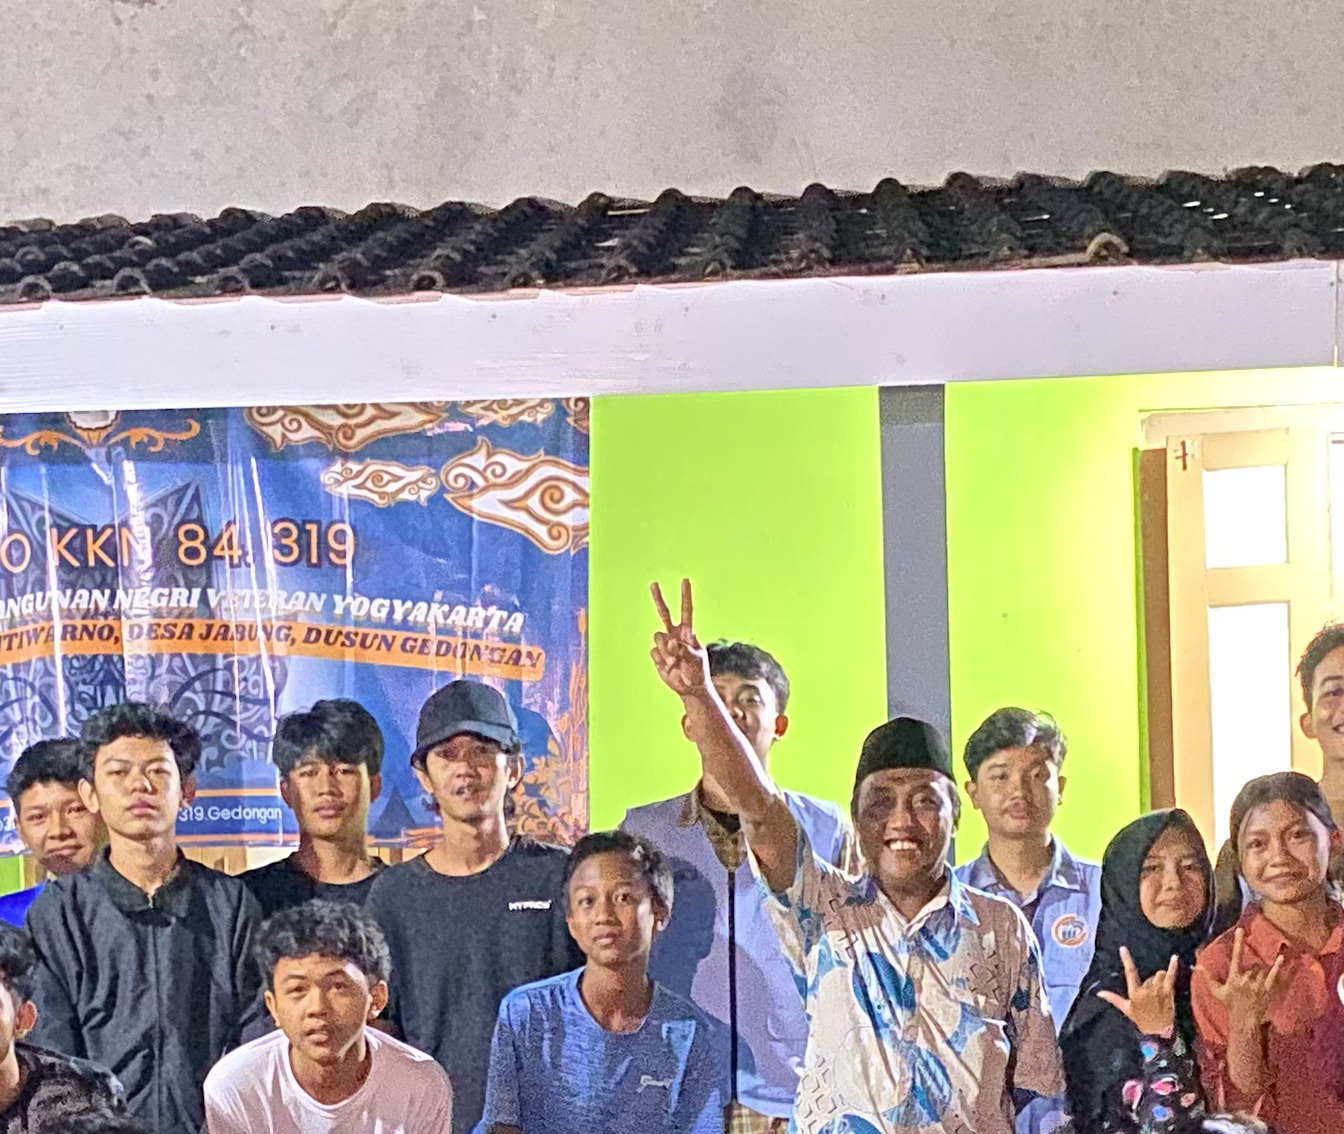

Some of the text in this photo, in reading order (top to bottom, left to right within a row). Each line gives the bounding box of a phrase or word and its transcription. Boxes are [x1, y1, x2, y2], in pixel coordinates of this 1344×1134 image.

[333, 594, 524, 633] YOGYAKARTA
[127, 622, 193, 642] DESA
[304, 626, 397, 652] DUSUN
[400, 636, 545, 669] GEDONGAN
